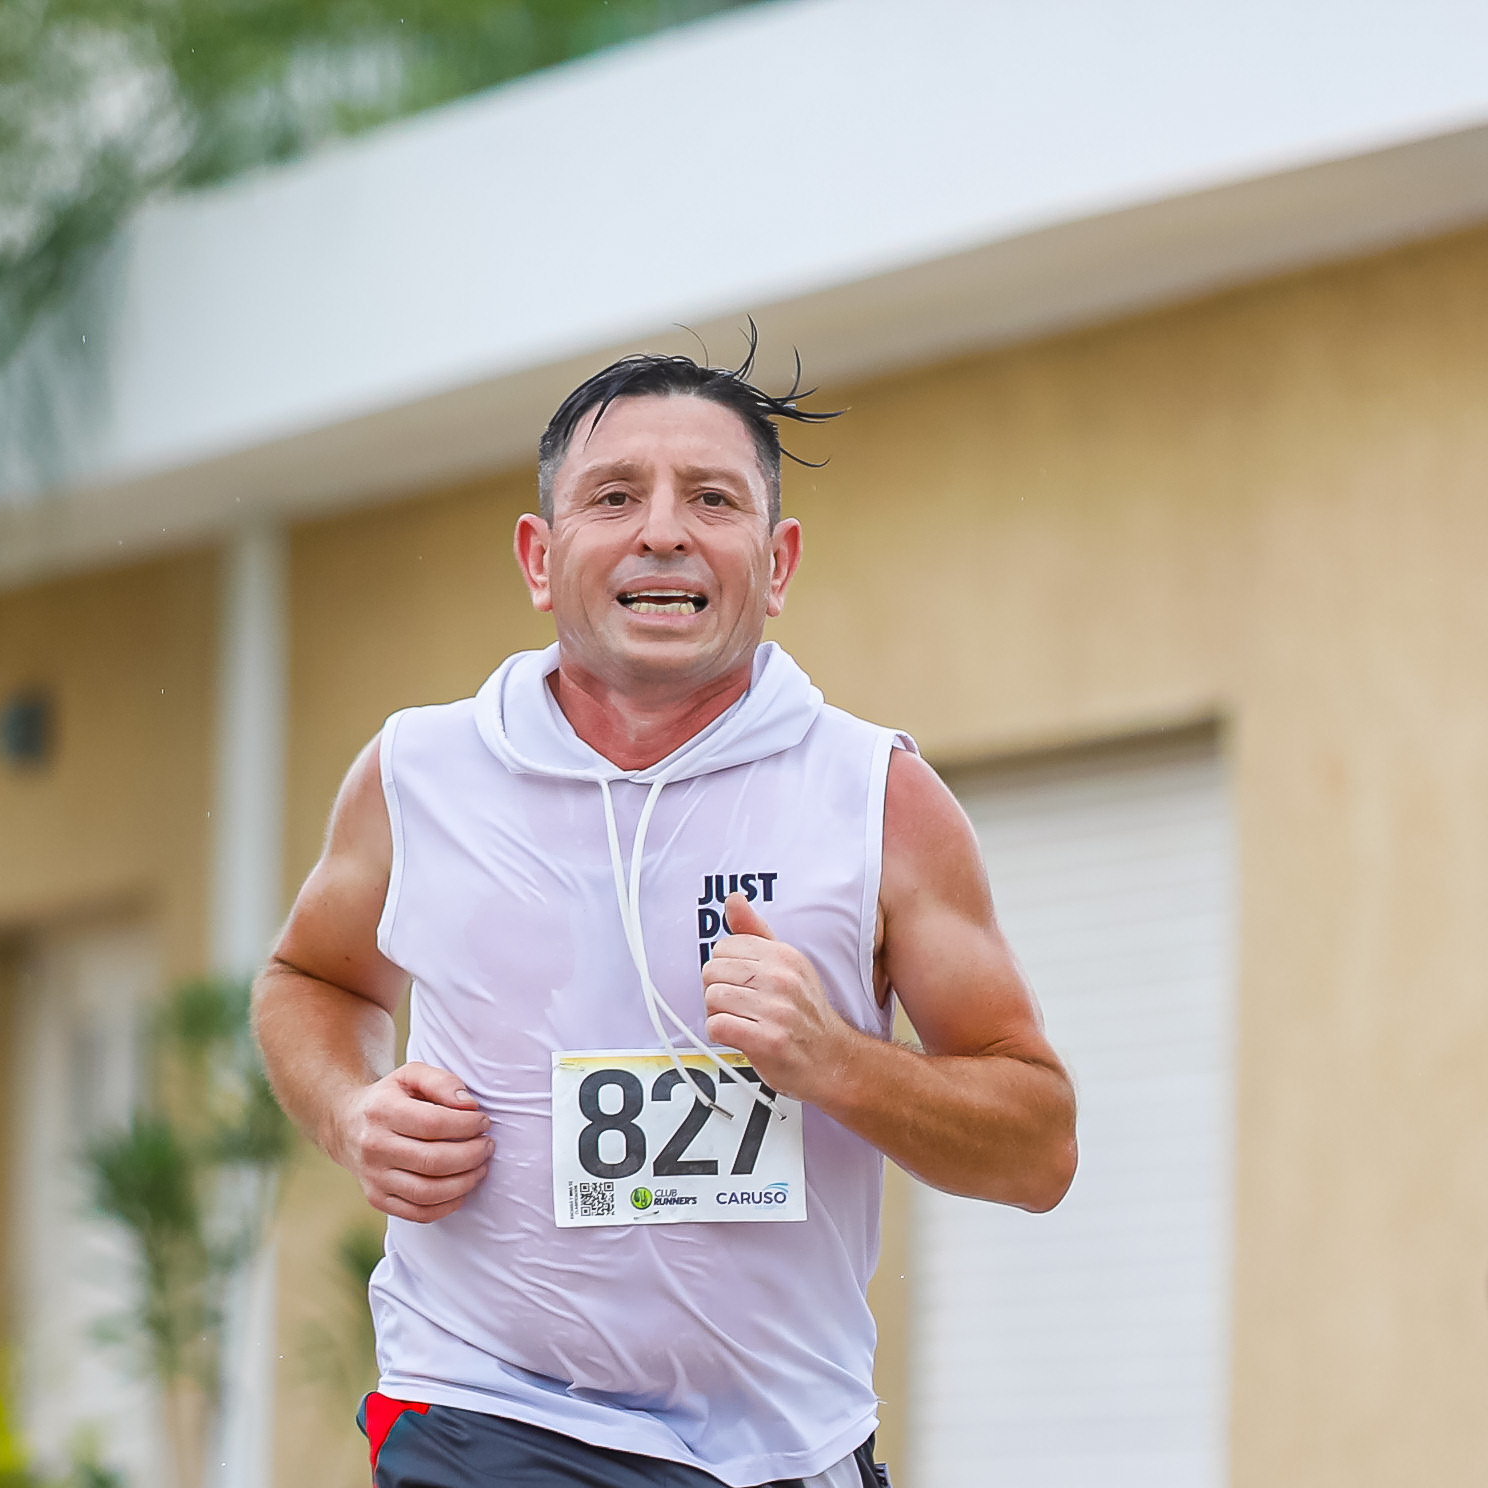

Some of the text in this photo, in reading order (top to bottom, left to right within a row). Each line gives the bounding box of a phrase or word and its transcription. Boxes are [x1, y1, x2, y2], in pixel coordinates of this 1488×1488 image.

[698, 872, 778, 905] JUST
[579, 1066, 778, 1179] 827
[654, 1189, 677, 1197] CLUB
[716, 1191, 787, 1204] CARUSO
